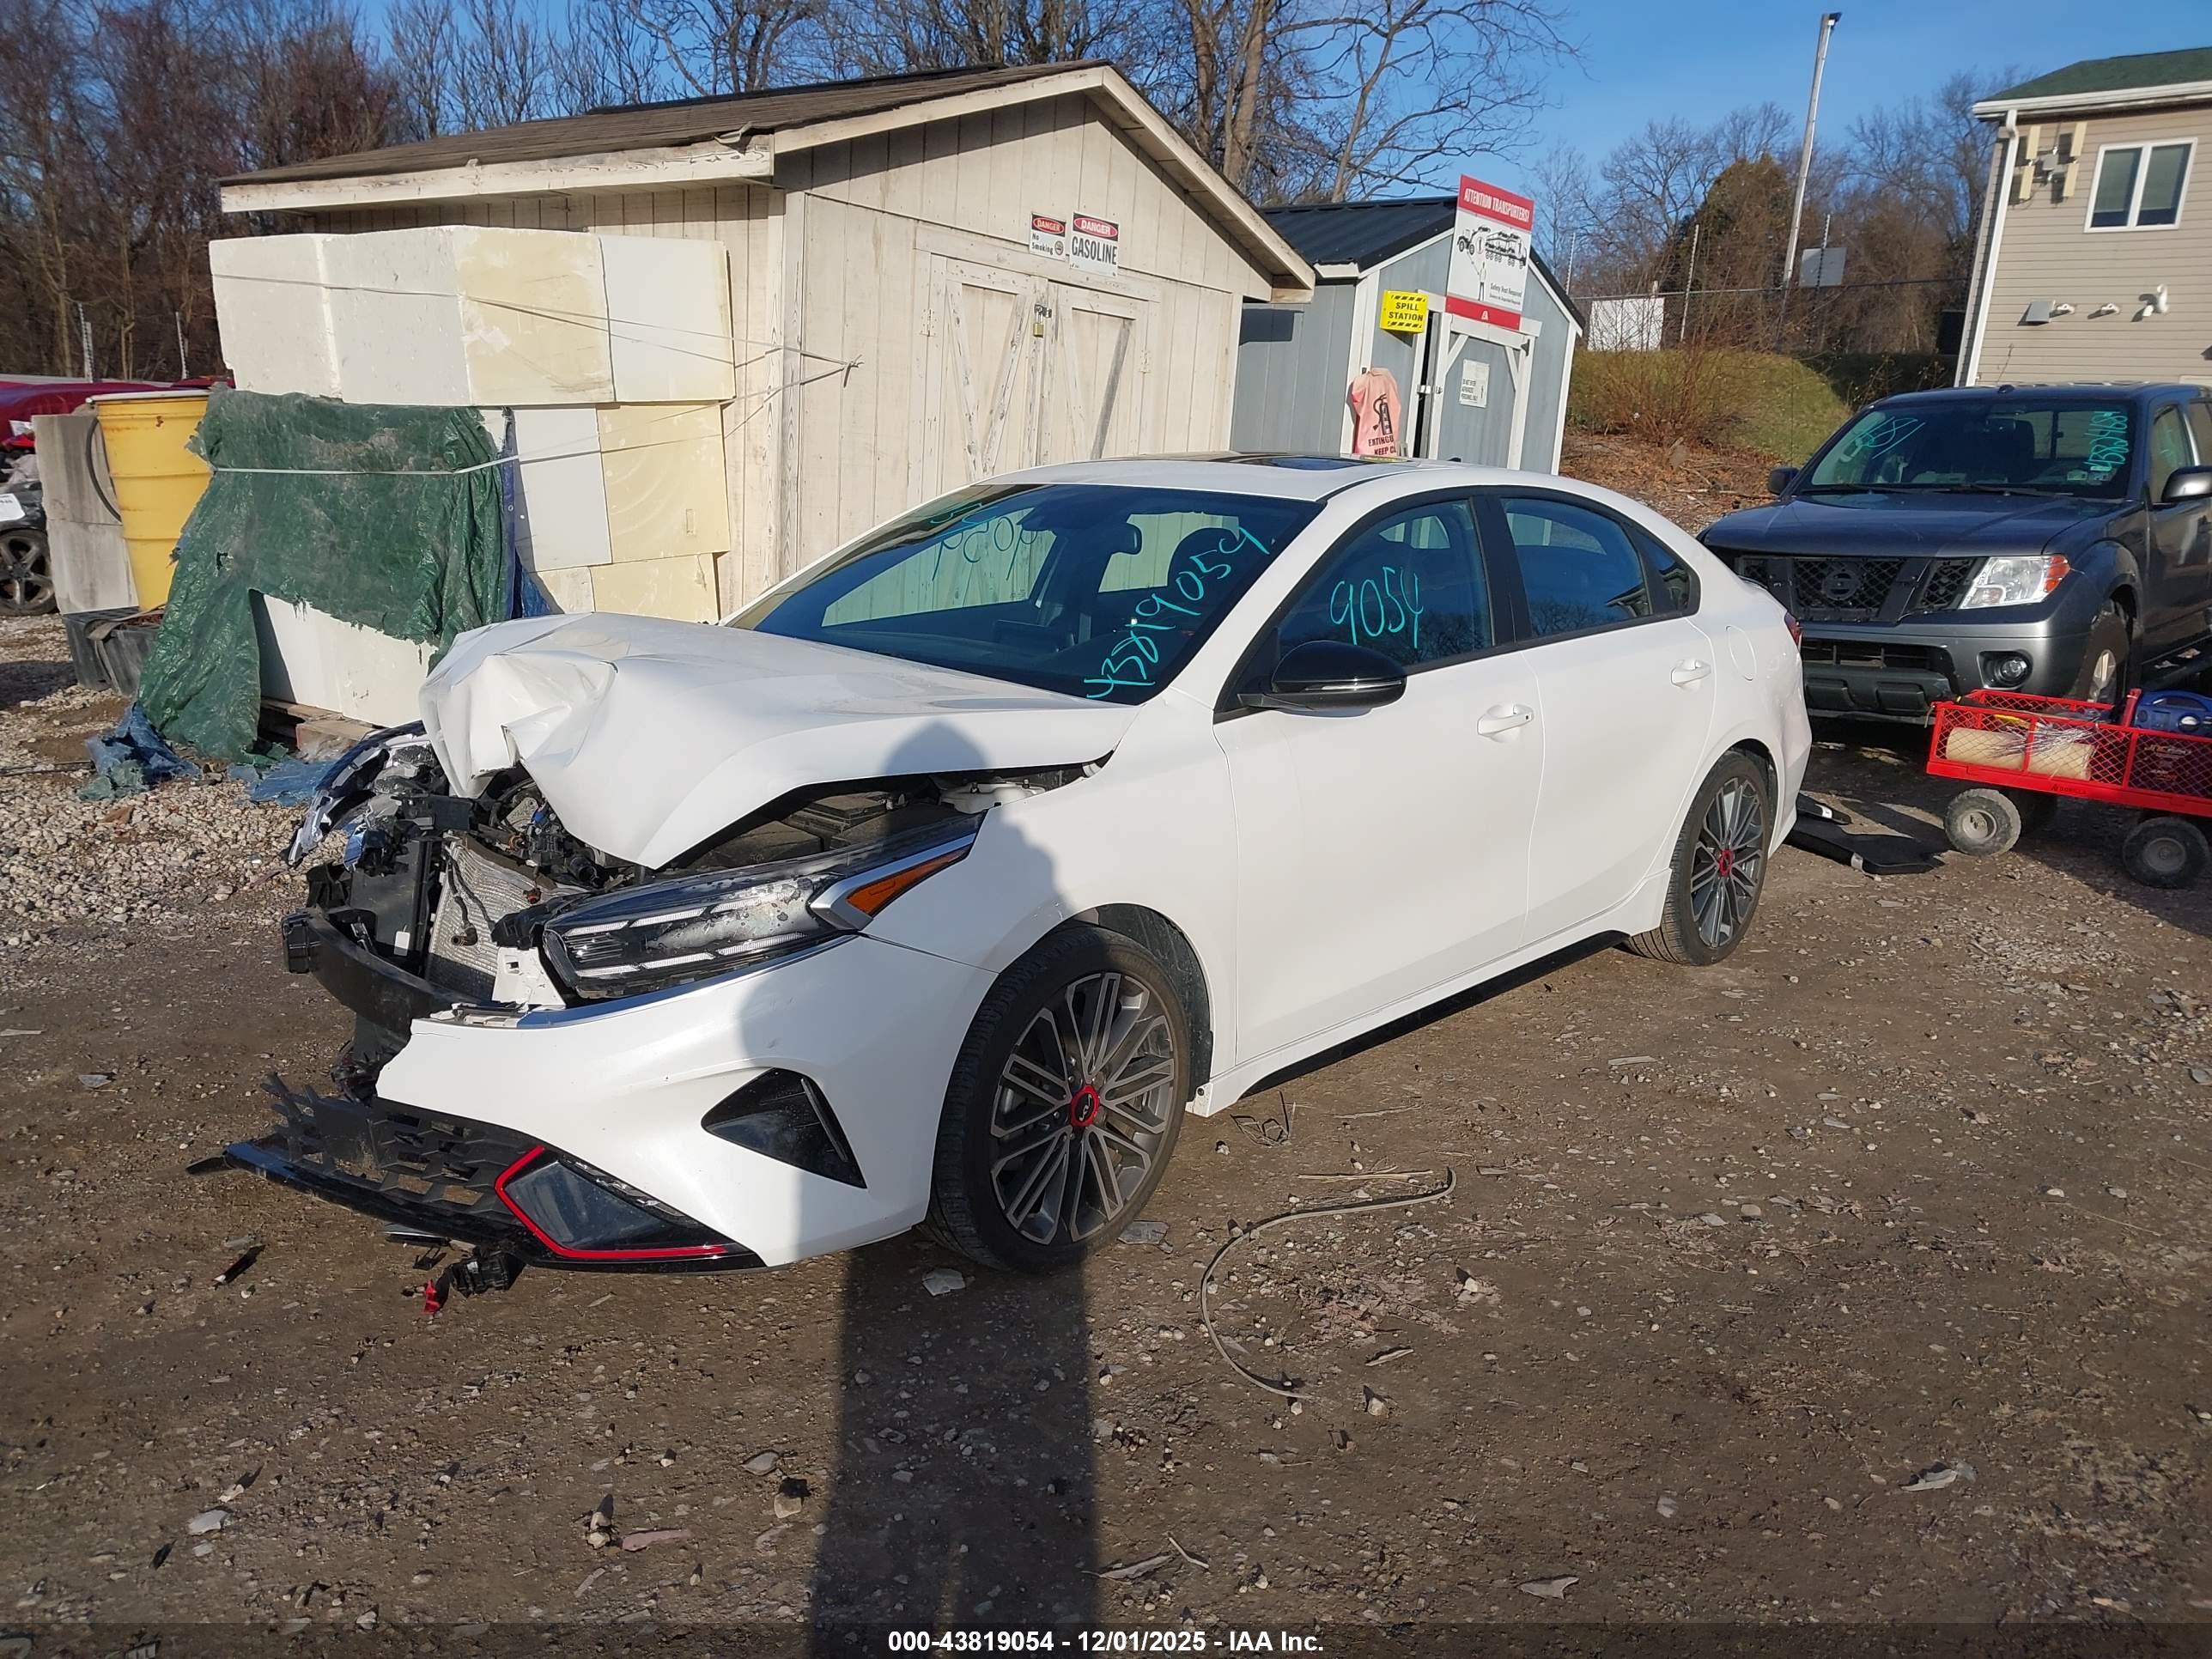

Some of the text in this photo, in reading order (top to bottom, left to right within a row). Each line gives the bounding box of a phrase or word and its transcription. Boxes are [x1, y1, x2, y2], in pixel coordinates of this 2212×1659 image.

[1464, 188, 1530, 222] ATTENTION TRANSPORTERS!
[1036, 219, 1060, 231] DANGER
[1081, 219, 1111, 235] DANGER
[1032, 242, 1054, 255] Smoking
[1071, 235, 1117, 265] GASOLINE
[1395, 301, 1419, 311] SPILL
[1388, 311, 1424, 322] STATION
[1374, 447, 1389, 456] KEEP
[1329, 566, 1425, 649] 9054
